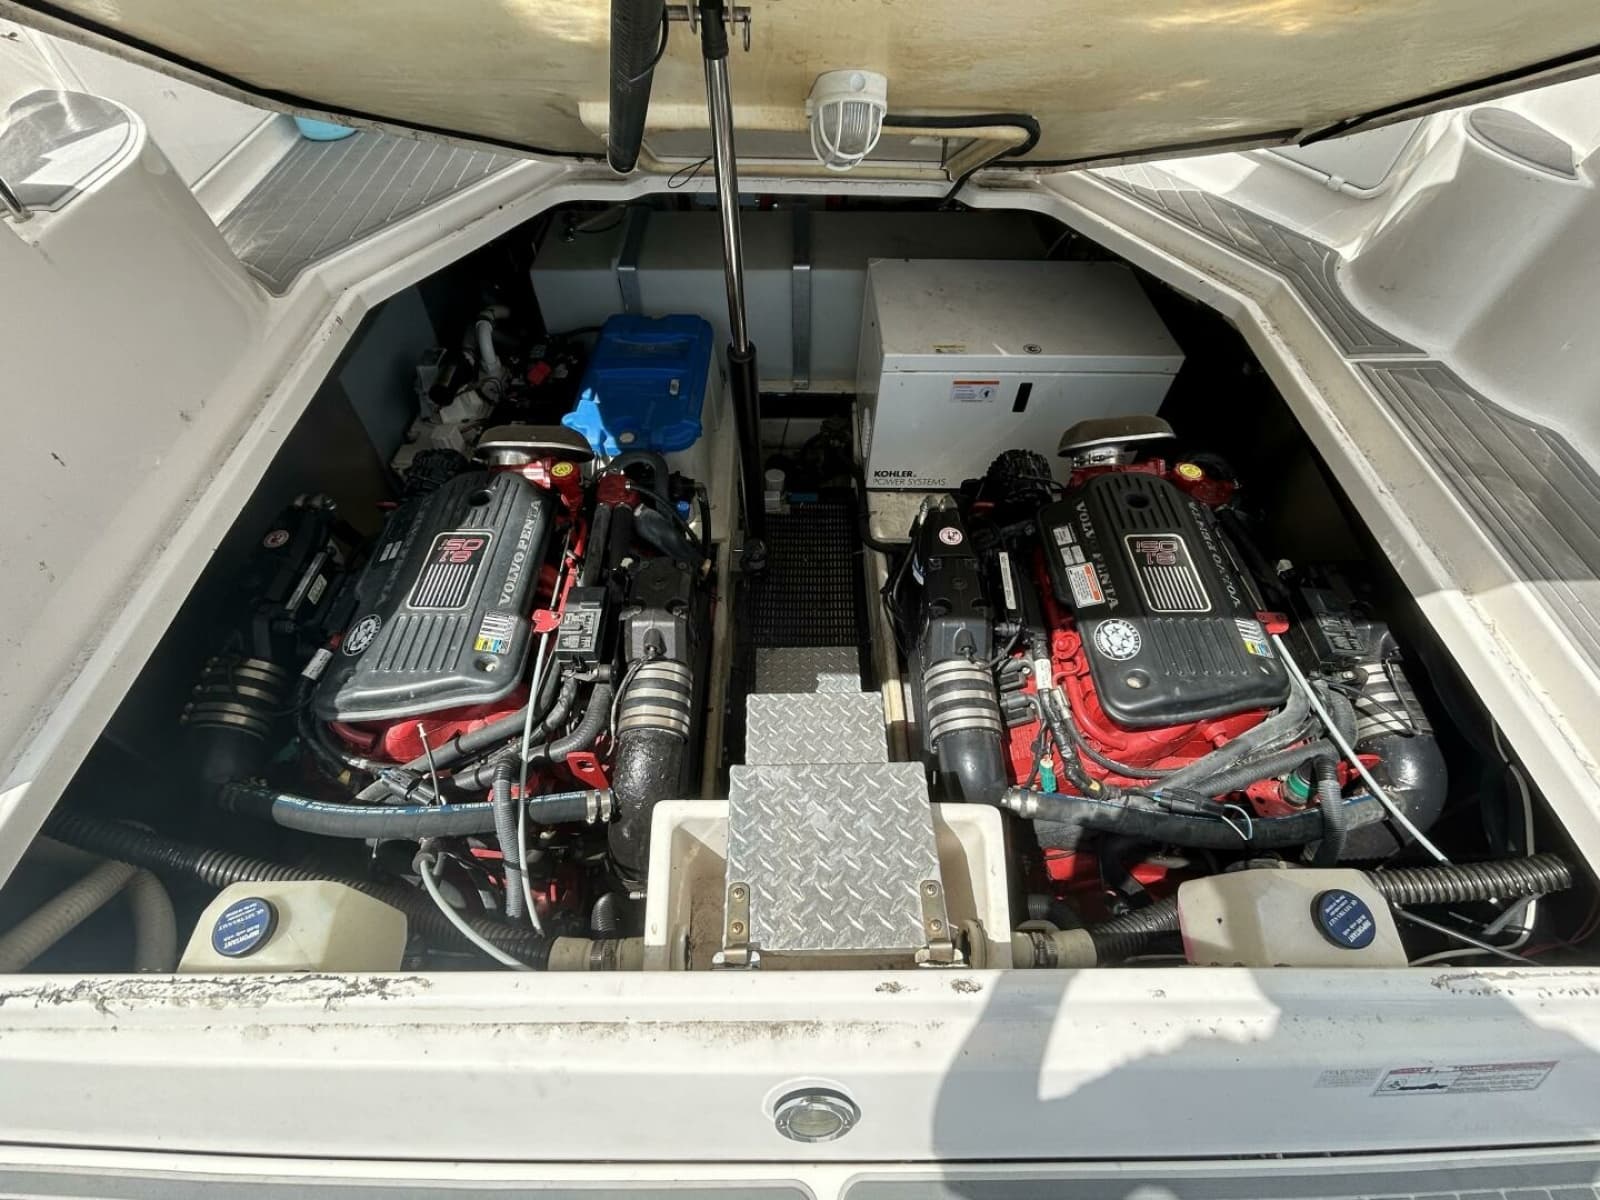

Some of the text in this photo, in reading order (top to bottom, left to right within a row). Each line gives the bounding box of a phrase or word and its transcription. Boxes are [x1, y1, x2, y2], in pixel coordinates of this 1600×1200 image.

[873, 470, 913, 478] KOHLER
[873, 478, 947, 486] POWER SYSTEMS
[498, 500, 541, 606] VOLVO PENTA
